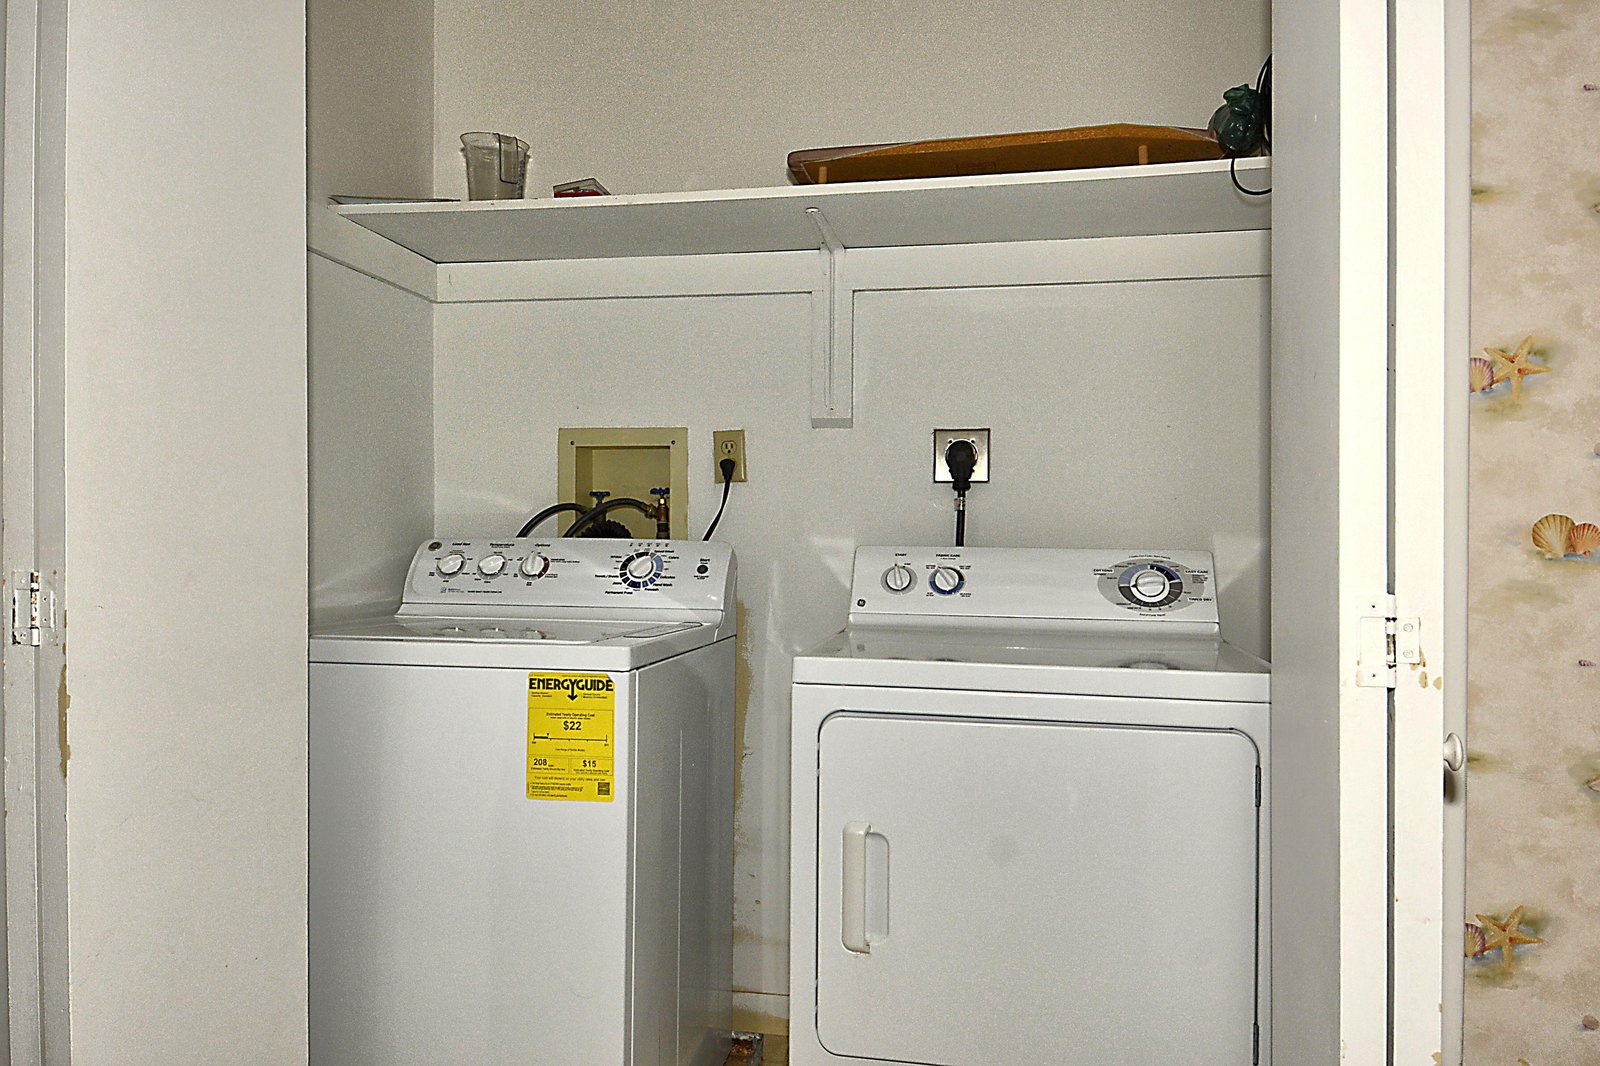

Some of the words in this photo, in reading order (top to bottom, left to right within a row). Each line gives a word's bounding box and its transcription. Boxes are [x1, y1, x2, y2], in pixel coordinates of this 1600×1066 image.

[529, 678, 614, 692] ENERGYGUIDE
[563, 720, 582, 731] $22
[533, 758, 548, 766] 208
[582, 759, 597, 768] $15
